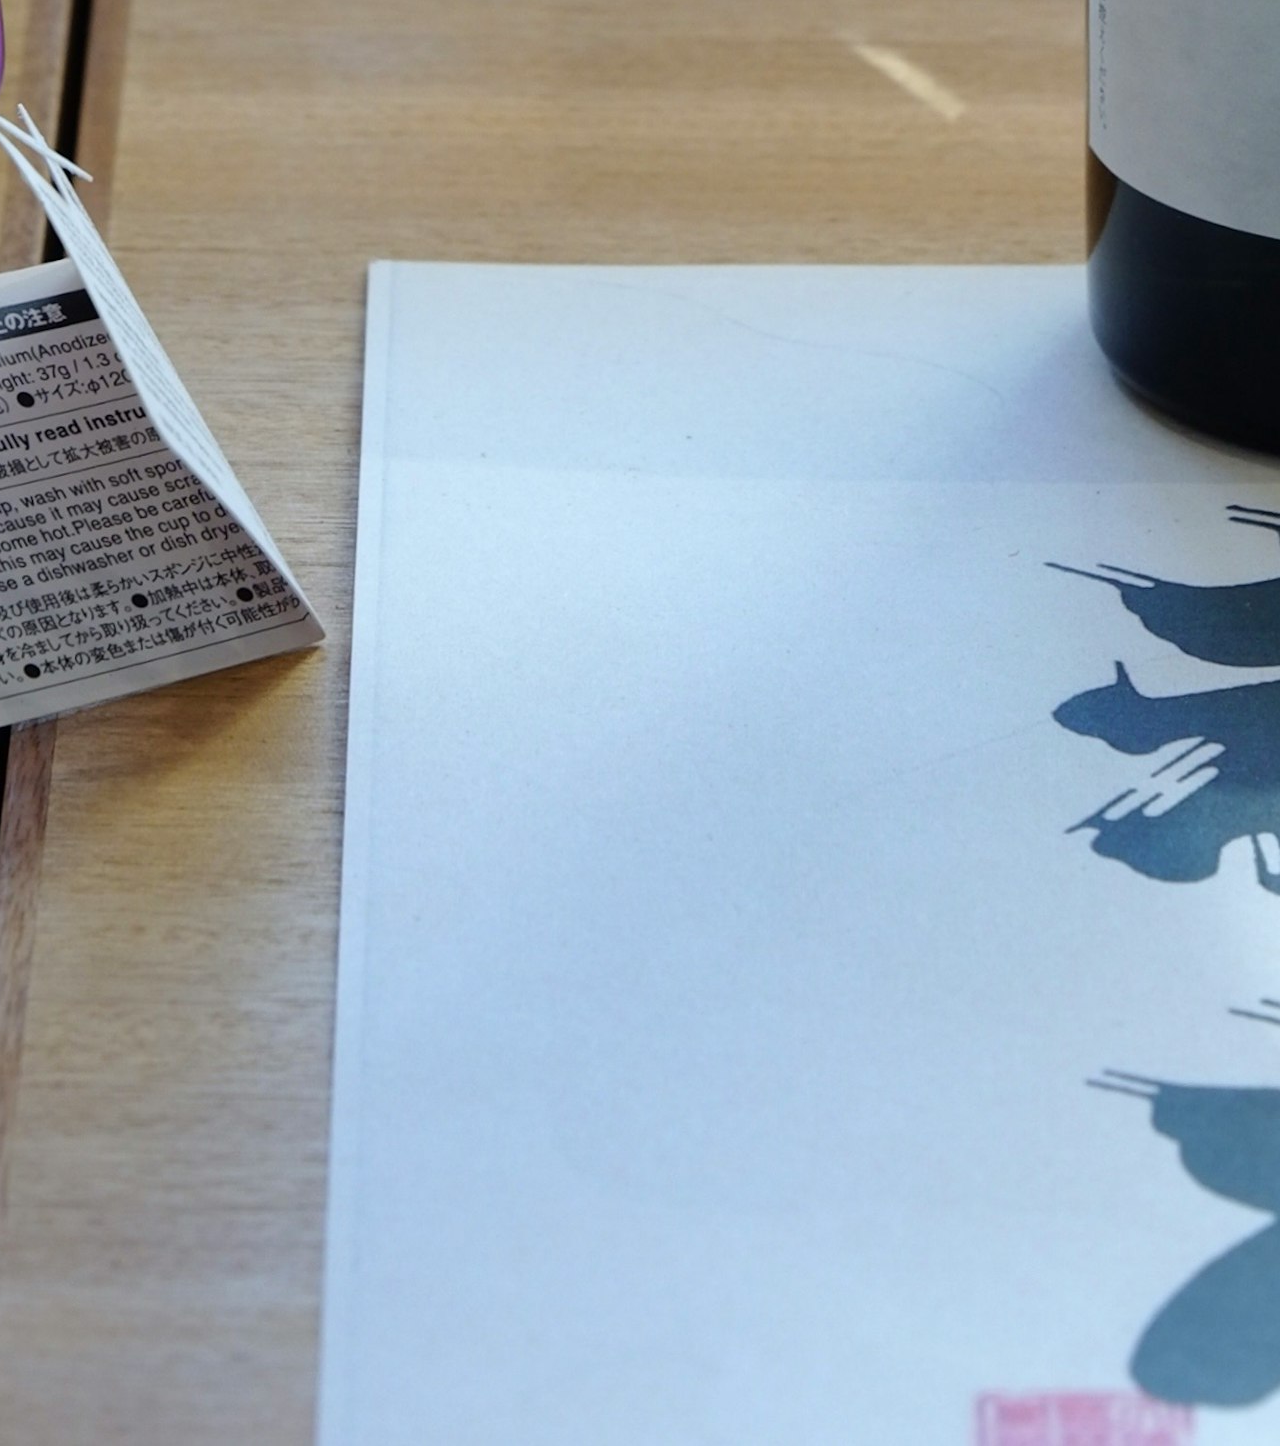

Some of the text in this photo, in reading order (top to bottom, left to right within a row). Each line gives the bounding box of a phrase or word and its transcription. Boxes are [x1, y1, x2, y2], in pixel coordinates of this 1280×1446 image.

[36, 365, 71, 384] 37g
[84, 352, 111, 372] 1.3
[34, 420, 83, 444] read
[20, 486, 68, 509] wash
[69, 477, 106, 497] with
[108, 467, 143, 488] soft
[51, 506, 63, 521] it
[67, 500, 102, 517] may
[107, 485, 161, 508] cause
[133, 504, 160, 520] be
[30, 546, 67, 564] may
[70, 532, 123, 556] cause
[124, 524, 155, 541] the
[158, 513, 191, 533] cup
[192, 508, 213, 524] to
[23, 574, 36, 586] a
[36, 548, 136, 582] dishwasher
[138, 544, 157, 559] or
[160, 532, 200, 553] dish
